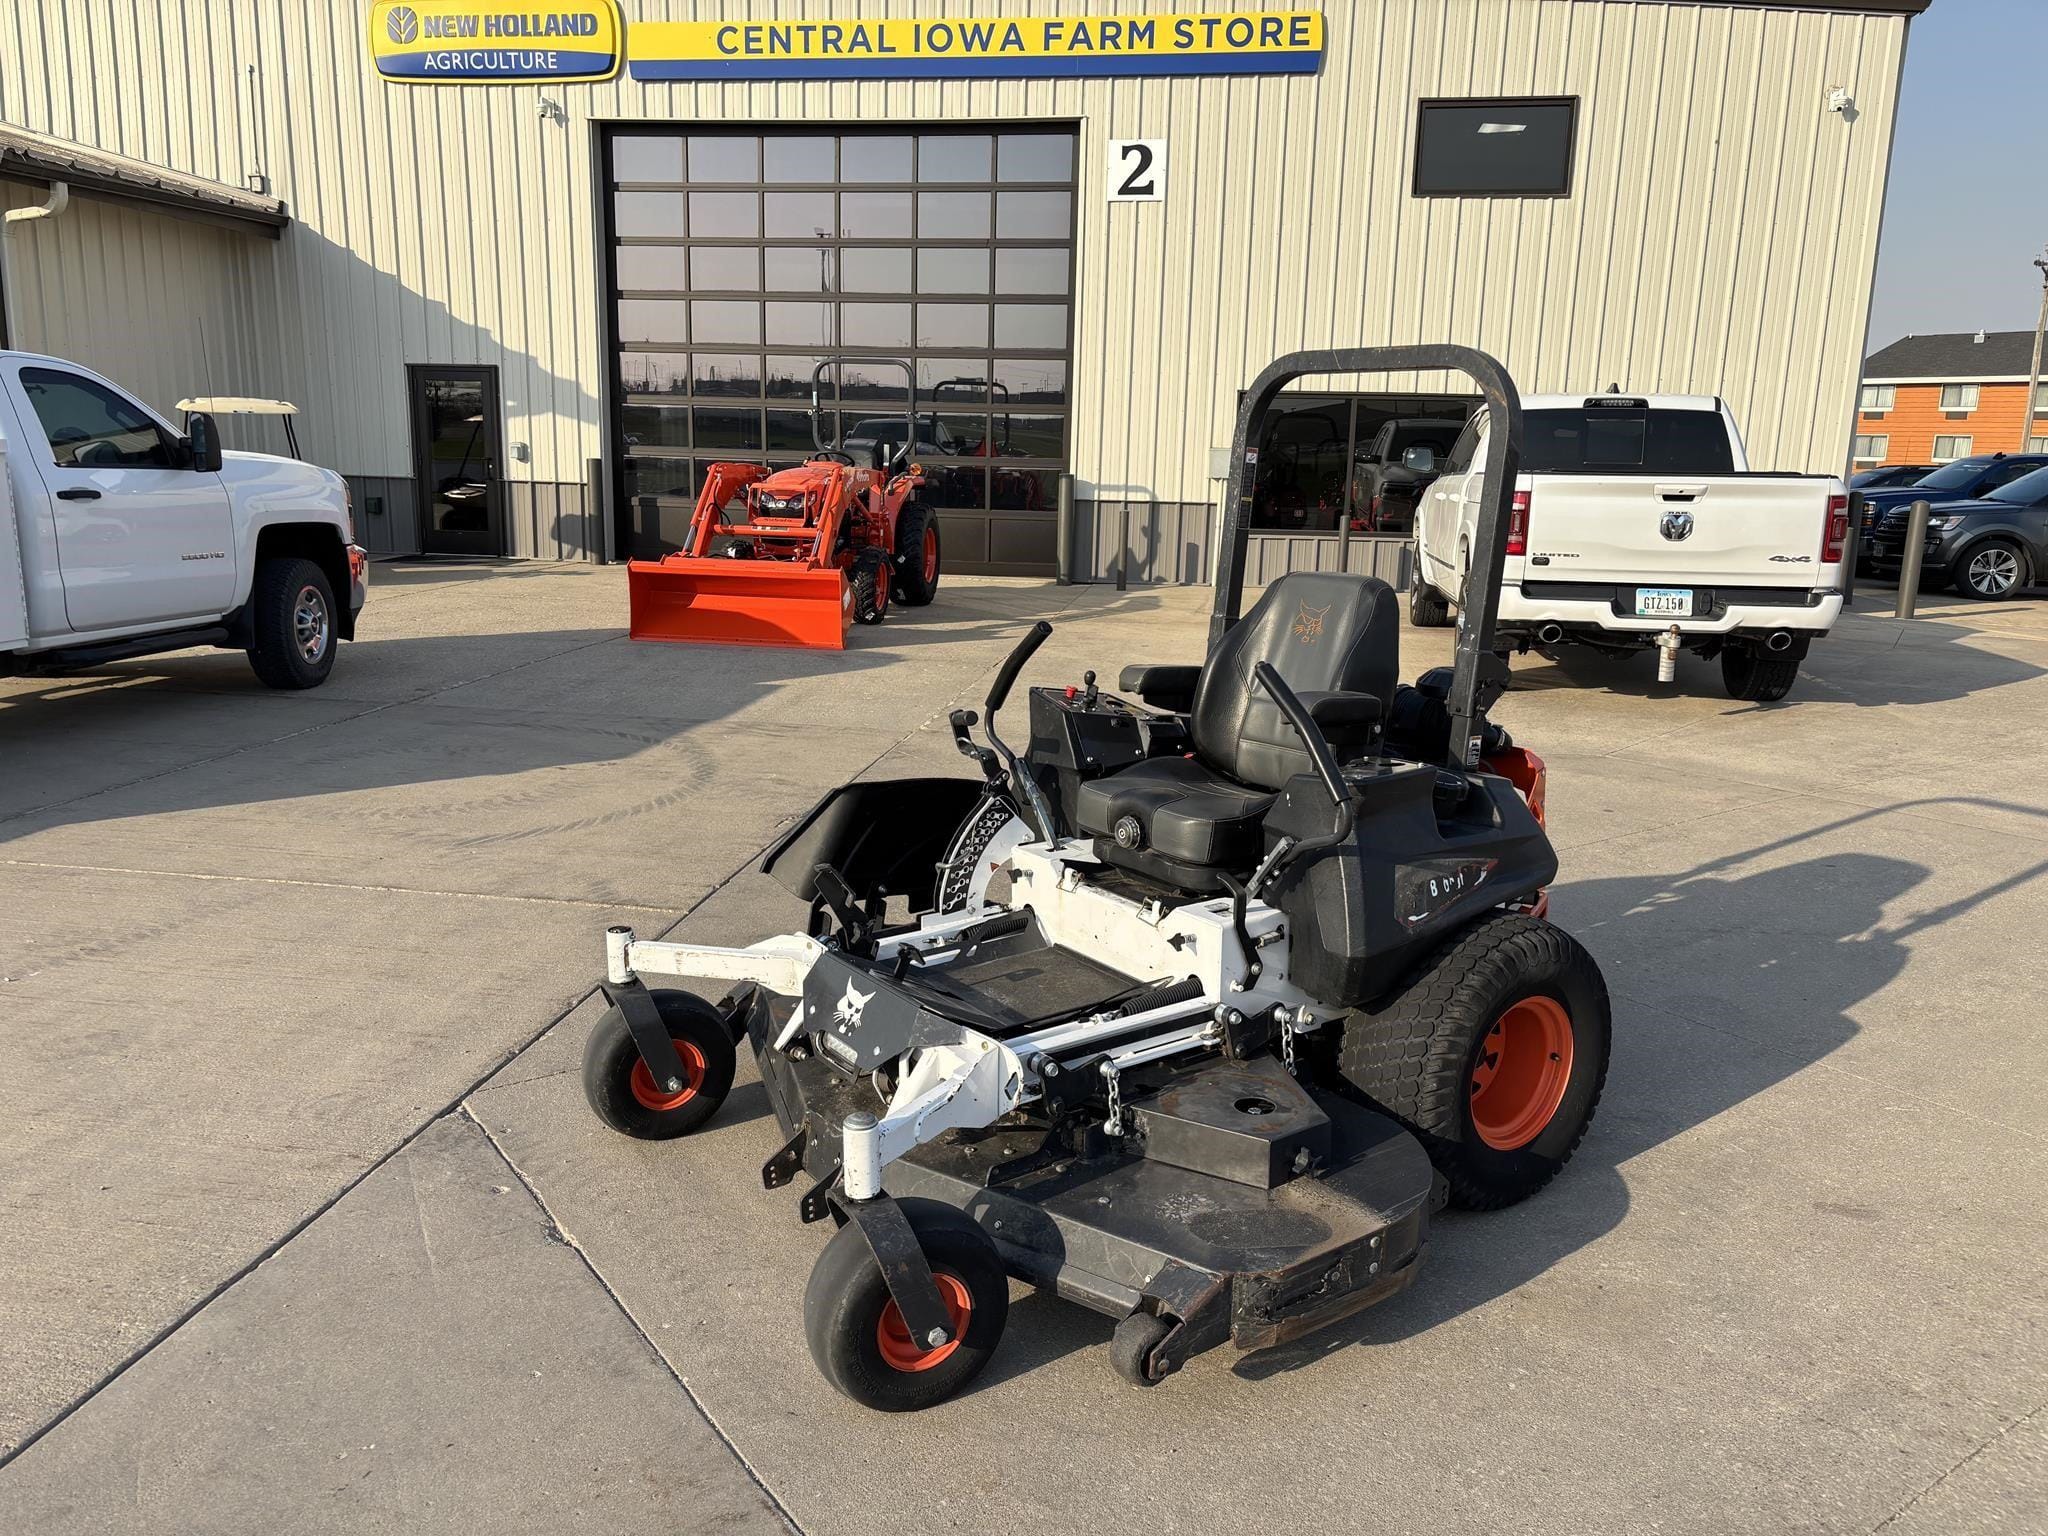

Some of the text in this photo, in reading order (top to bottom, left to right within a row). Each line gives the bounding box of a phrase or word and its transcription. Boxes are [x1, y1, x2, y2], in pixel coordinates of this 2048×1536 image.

[424, 13, 598, 38] NEW HOLLAND
[716, 16, 1311, 54] CENTRAL IOWA FARM STORE
[424, 52, 558, 70] AGRICULTURE
[1117, 144, 1154, 195] 2
